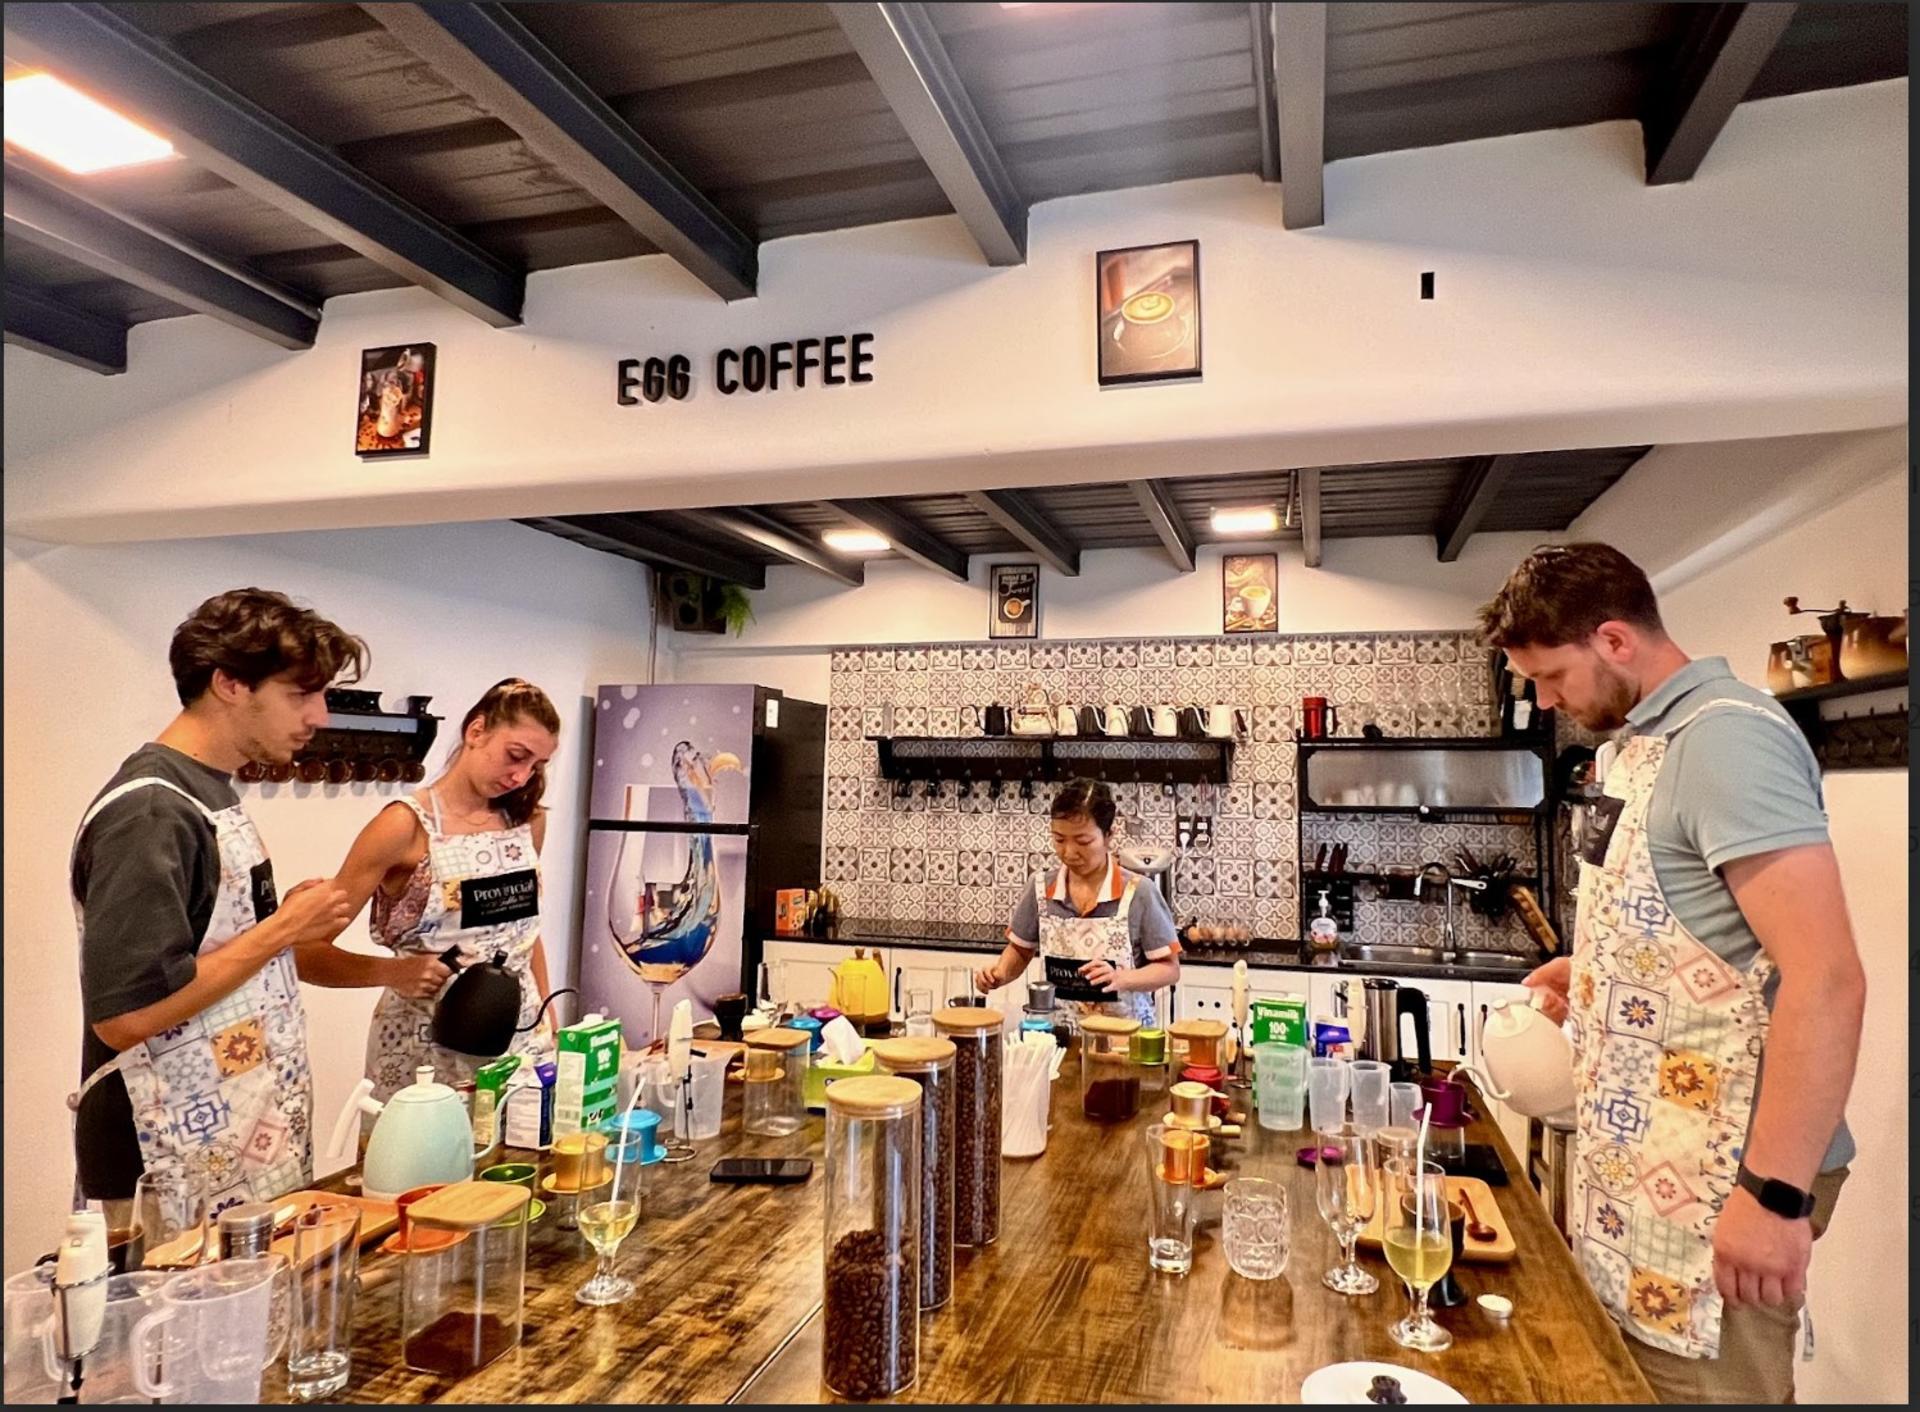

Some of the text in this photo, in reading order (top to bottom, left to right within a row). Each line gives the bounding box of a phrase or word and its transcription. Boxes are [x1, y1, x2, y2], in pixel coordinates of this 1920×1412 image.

[617, 333, 875, 406] EGG COFFEE
[473, 879, 533, 902] Provincial
